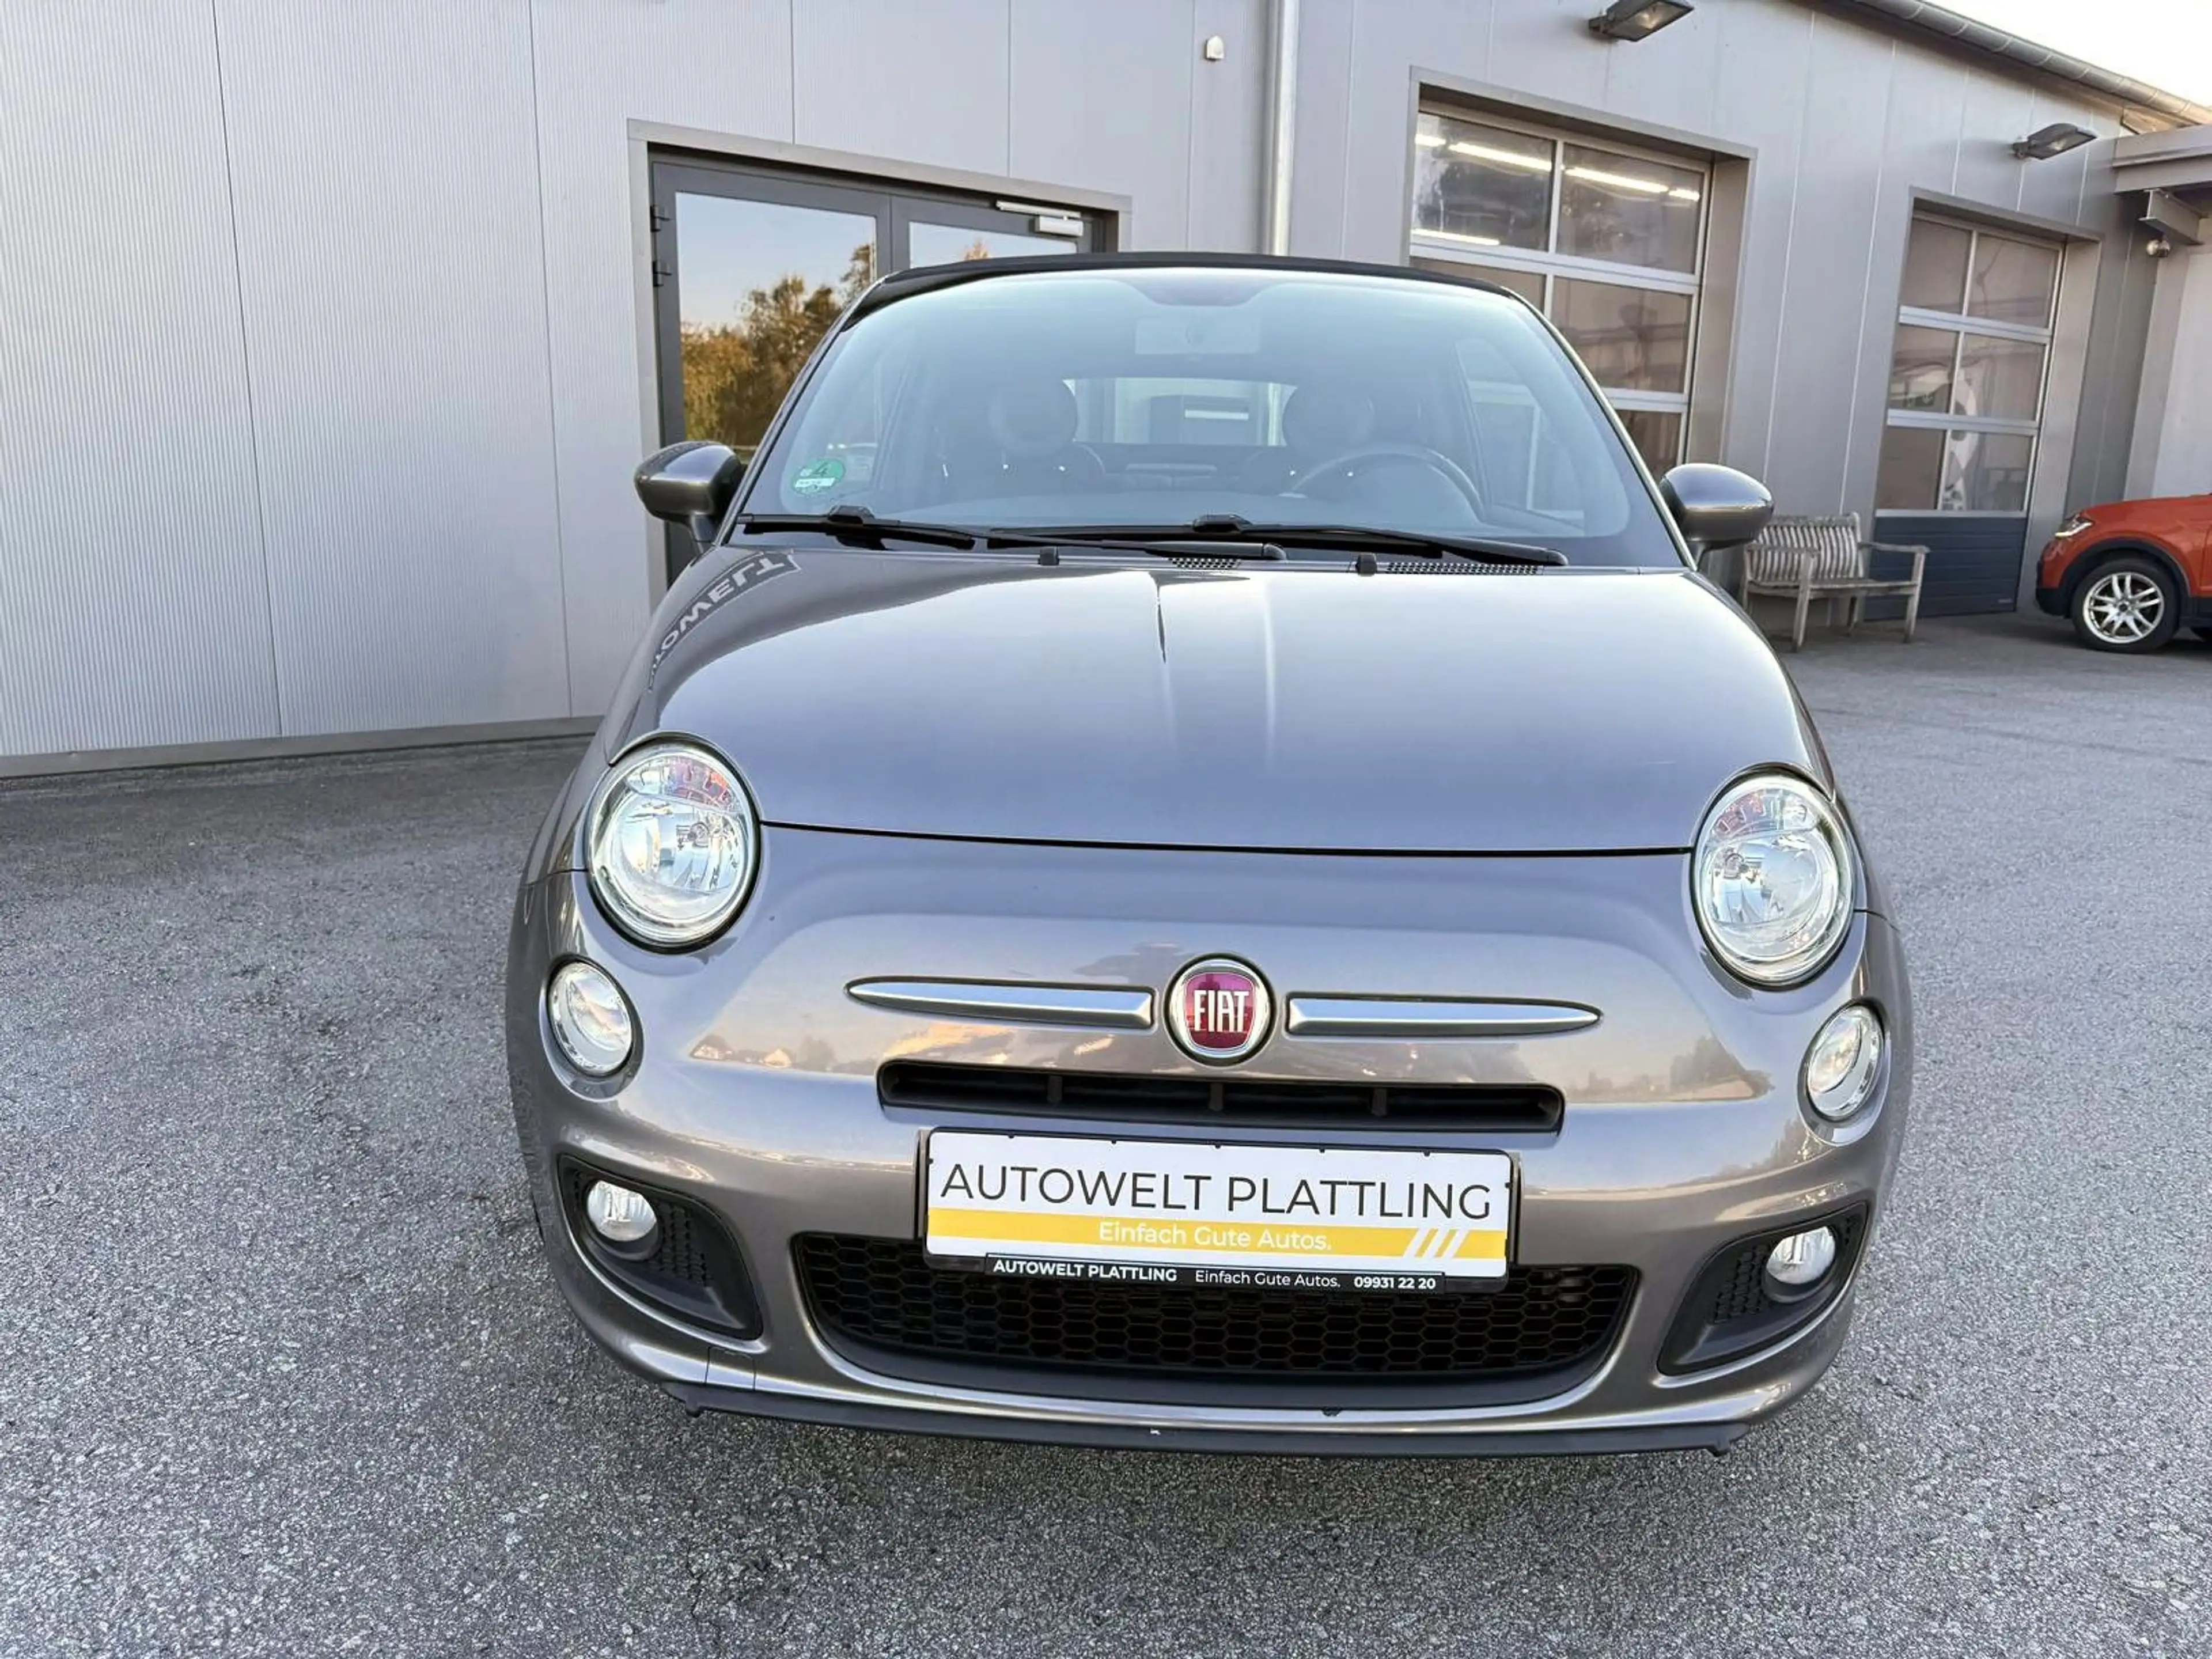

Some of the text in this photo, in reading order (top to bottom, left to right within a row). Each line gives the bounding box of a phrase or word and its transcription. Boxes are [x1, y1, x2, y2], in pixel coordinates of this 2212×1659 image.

[1194, 990, 1249, 1032] FIAT
[941, 1163, 1491, 1219] AUTOWELT PLATTLING
[1099, 1221, 1332, 1251] Einfach Gute Autos.
[993, 1259, 1436, 1290] AUTOWELT PLATTLING Einfach Gute Autos. 09931 22 20
